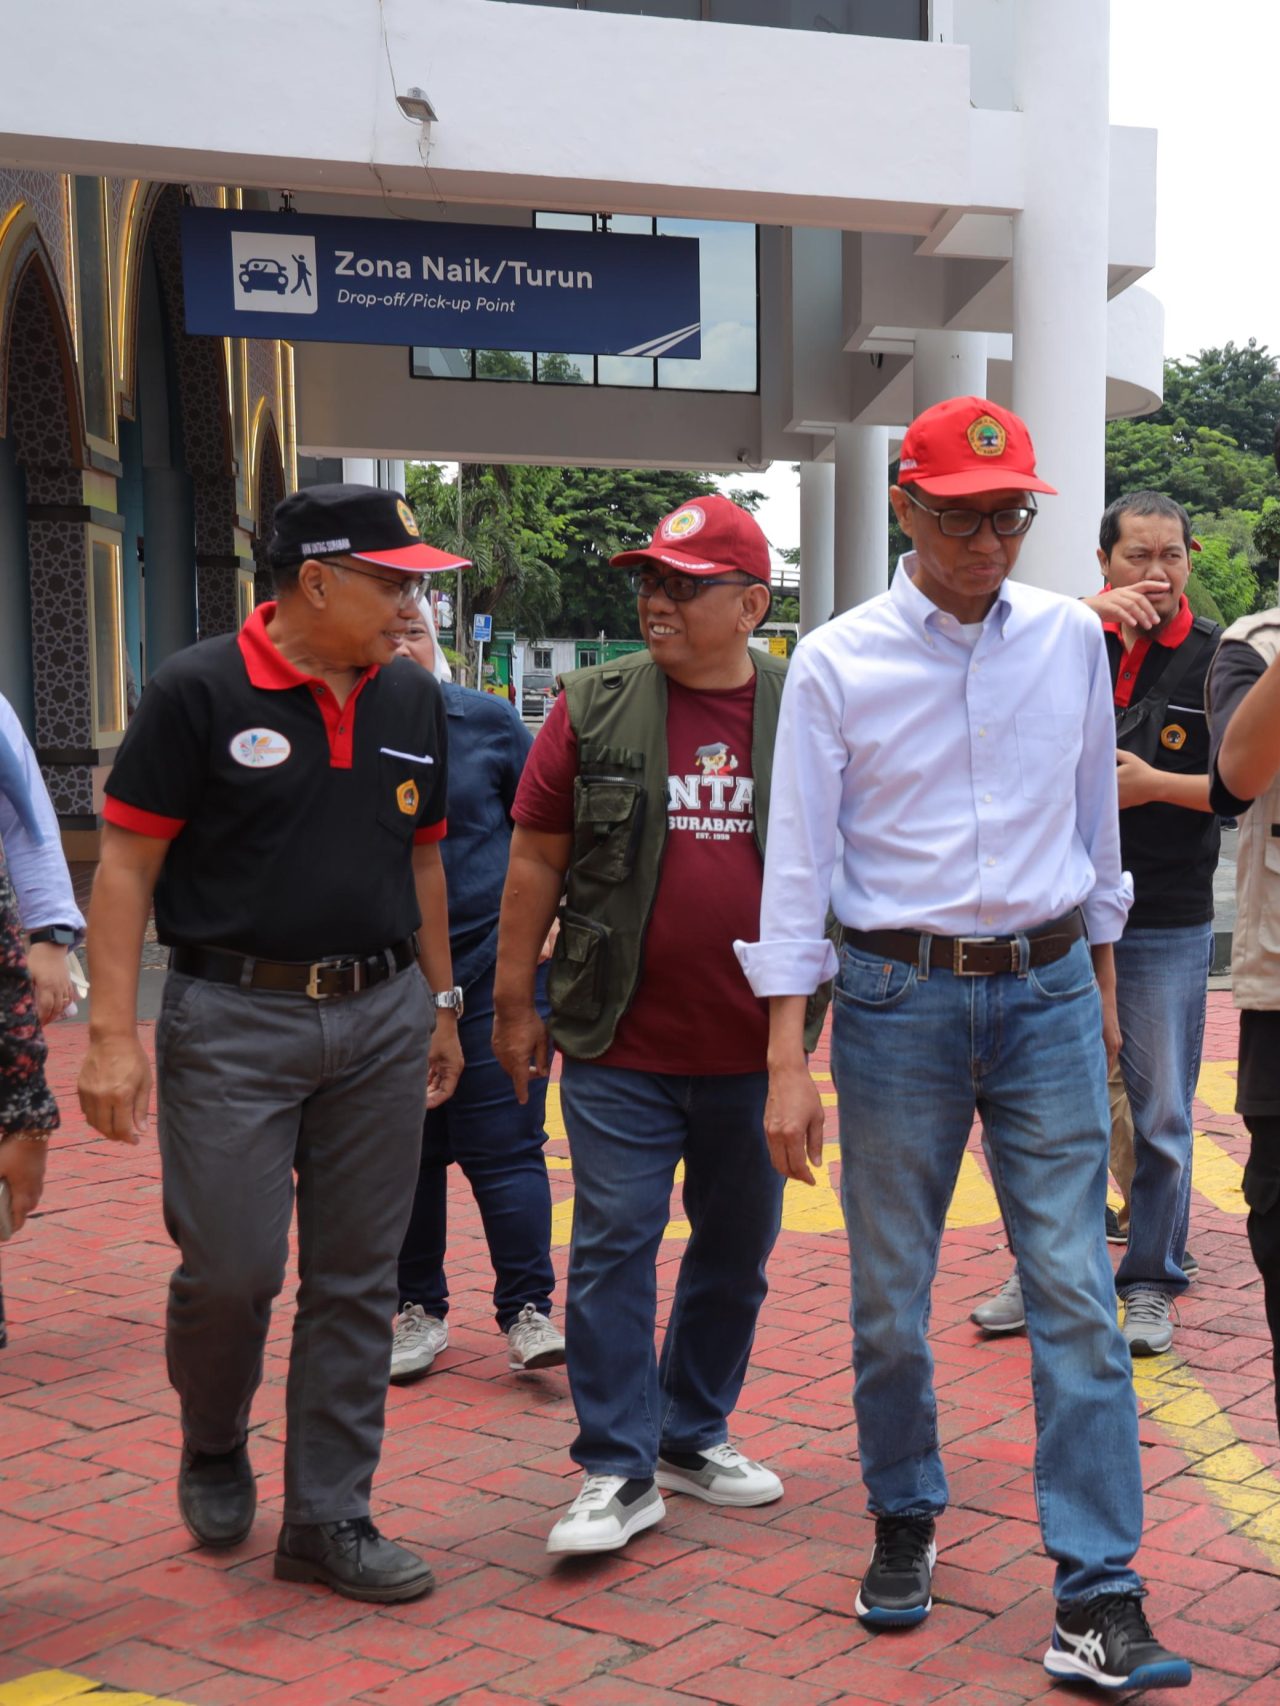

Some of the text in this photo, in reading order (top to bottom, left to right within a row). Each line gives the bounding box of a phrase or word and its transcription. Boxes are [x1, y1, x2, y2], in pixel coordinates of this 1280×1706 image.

[334, 250, 594, 290] Zona Naik/Turun
[337, 289, 516, 314] Drop-off/Pick-up Point
